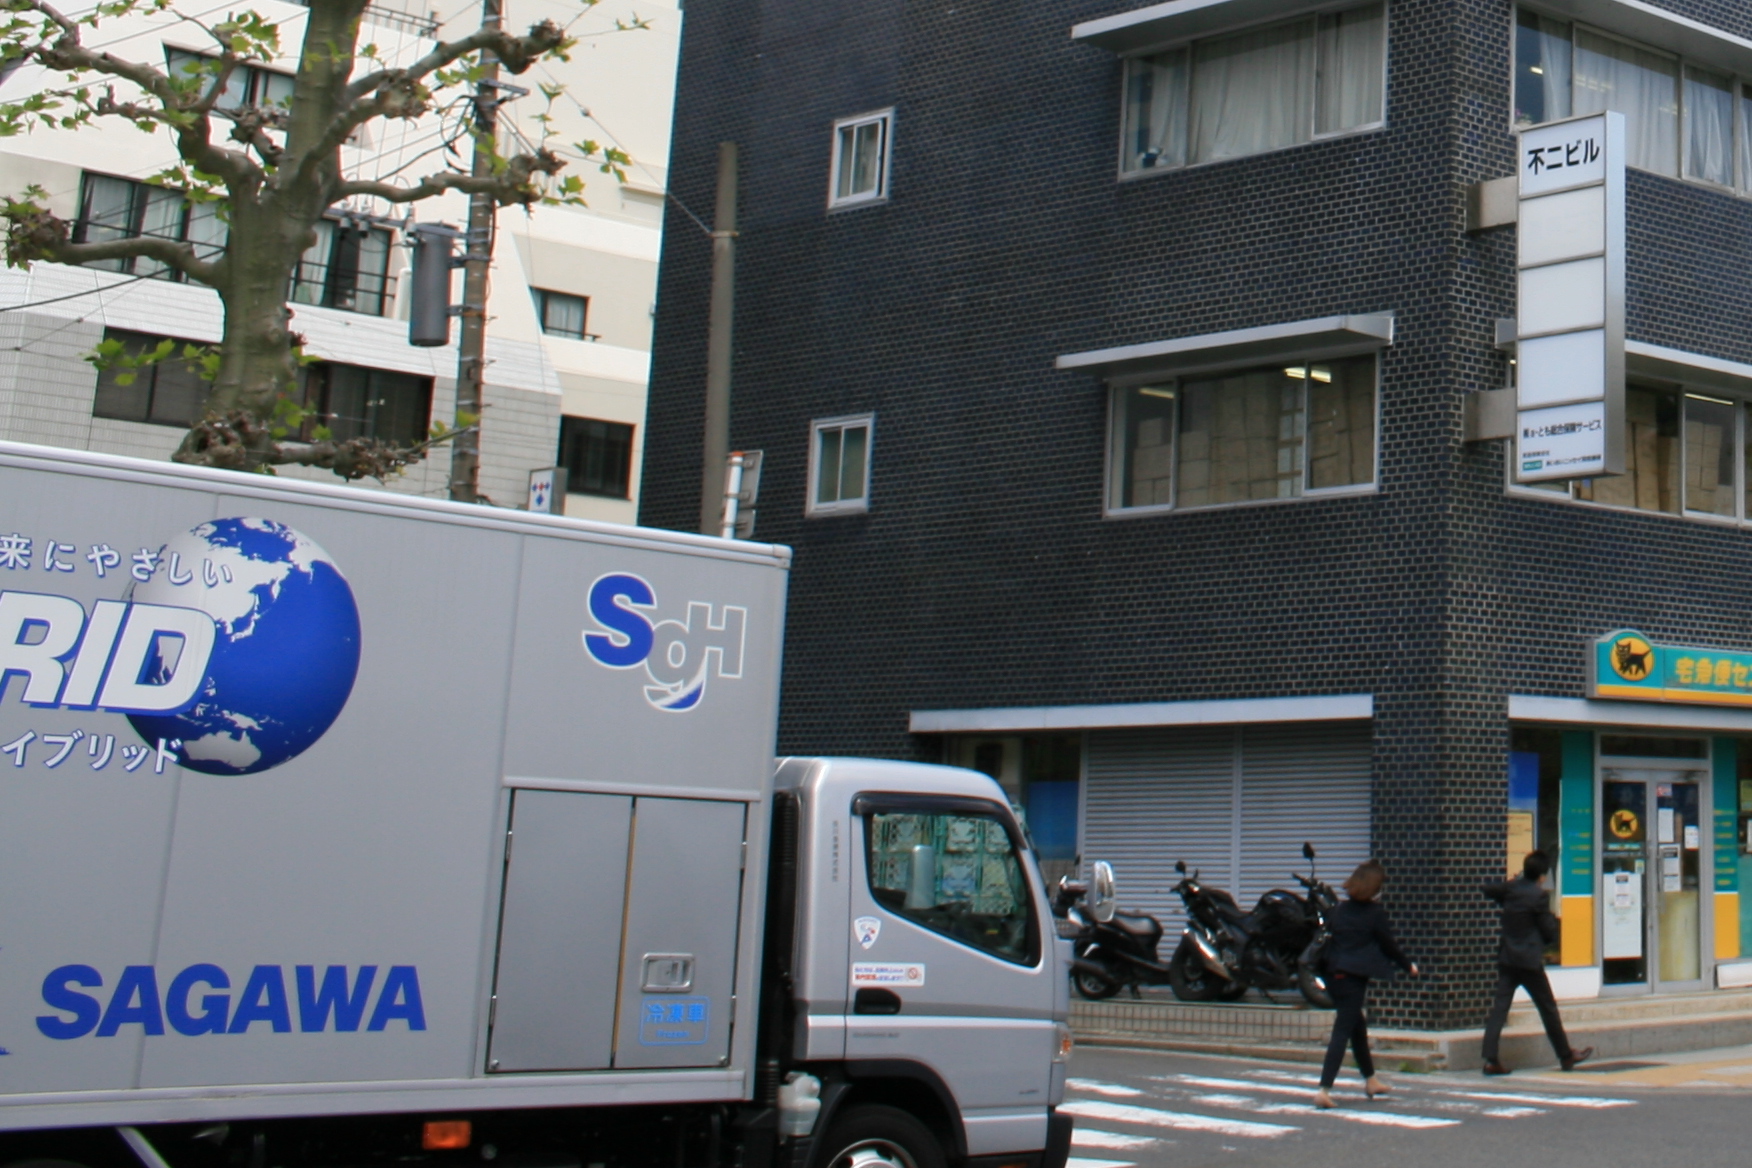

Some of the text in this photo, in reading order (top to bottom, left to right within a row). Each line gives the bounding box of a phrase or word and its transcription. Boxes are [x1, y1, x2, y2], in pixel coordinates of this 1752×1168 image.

[1527, 136, 1600, 176] 不二ビル
[0, 533, 234, 586] 来にやさしい
[582, 571, 748, 713] SgH
[36, 963, 427, 1041] SAGAWA
[645, 1003, 705, 1024] 冷凍車
